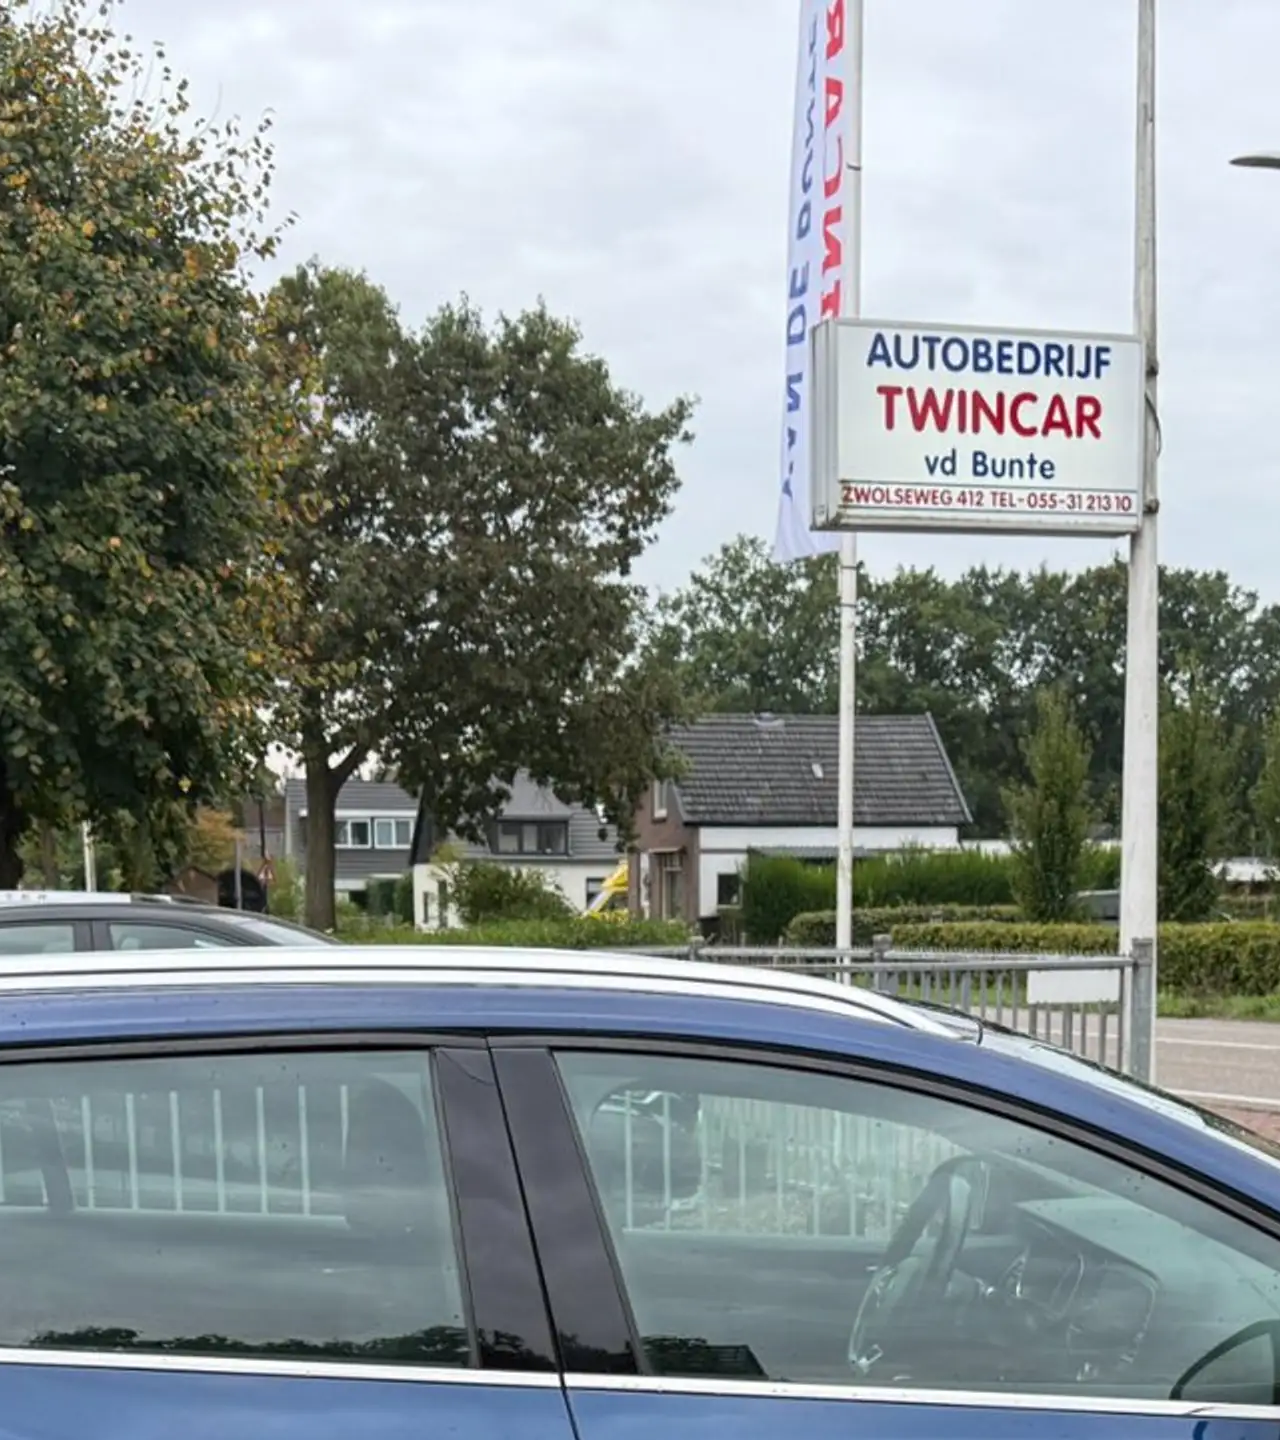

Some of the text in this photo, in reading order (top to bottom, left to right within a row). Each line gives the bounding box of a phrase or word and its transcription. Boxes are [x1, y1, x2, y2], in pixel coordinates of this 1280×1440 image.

[867, 333, 1112, 379] AUTOBEDRIJF
[876, 385, 1103, 440] TWINCAR
[925, 448, 1056, 480] vd Bunte
[841, 485, 953, 506] ZWOLSEWEG
[956, 490, 985, 507] 412
